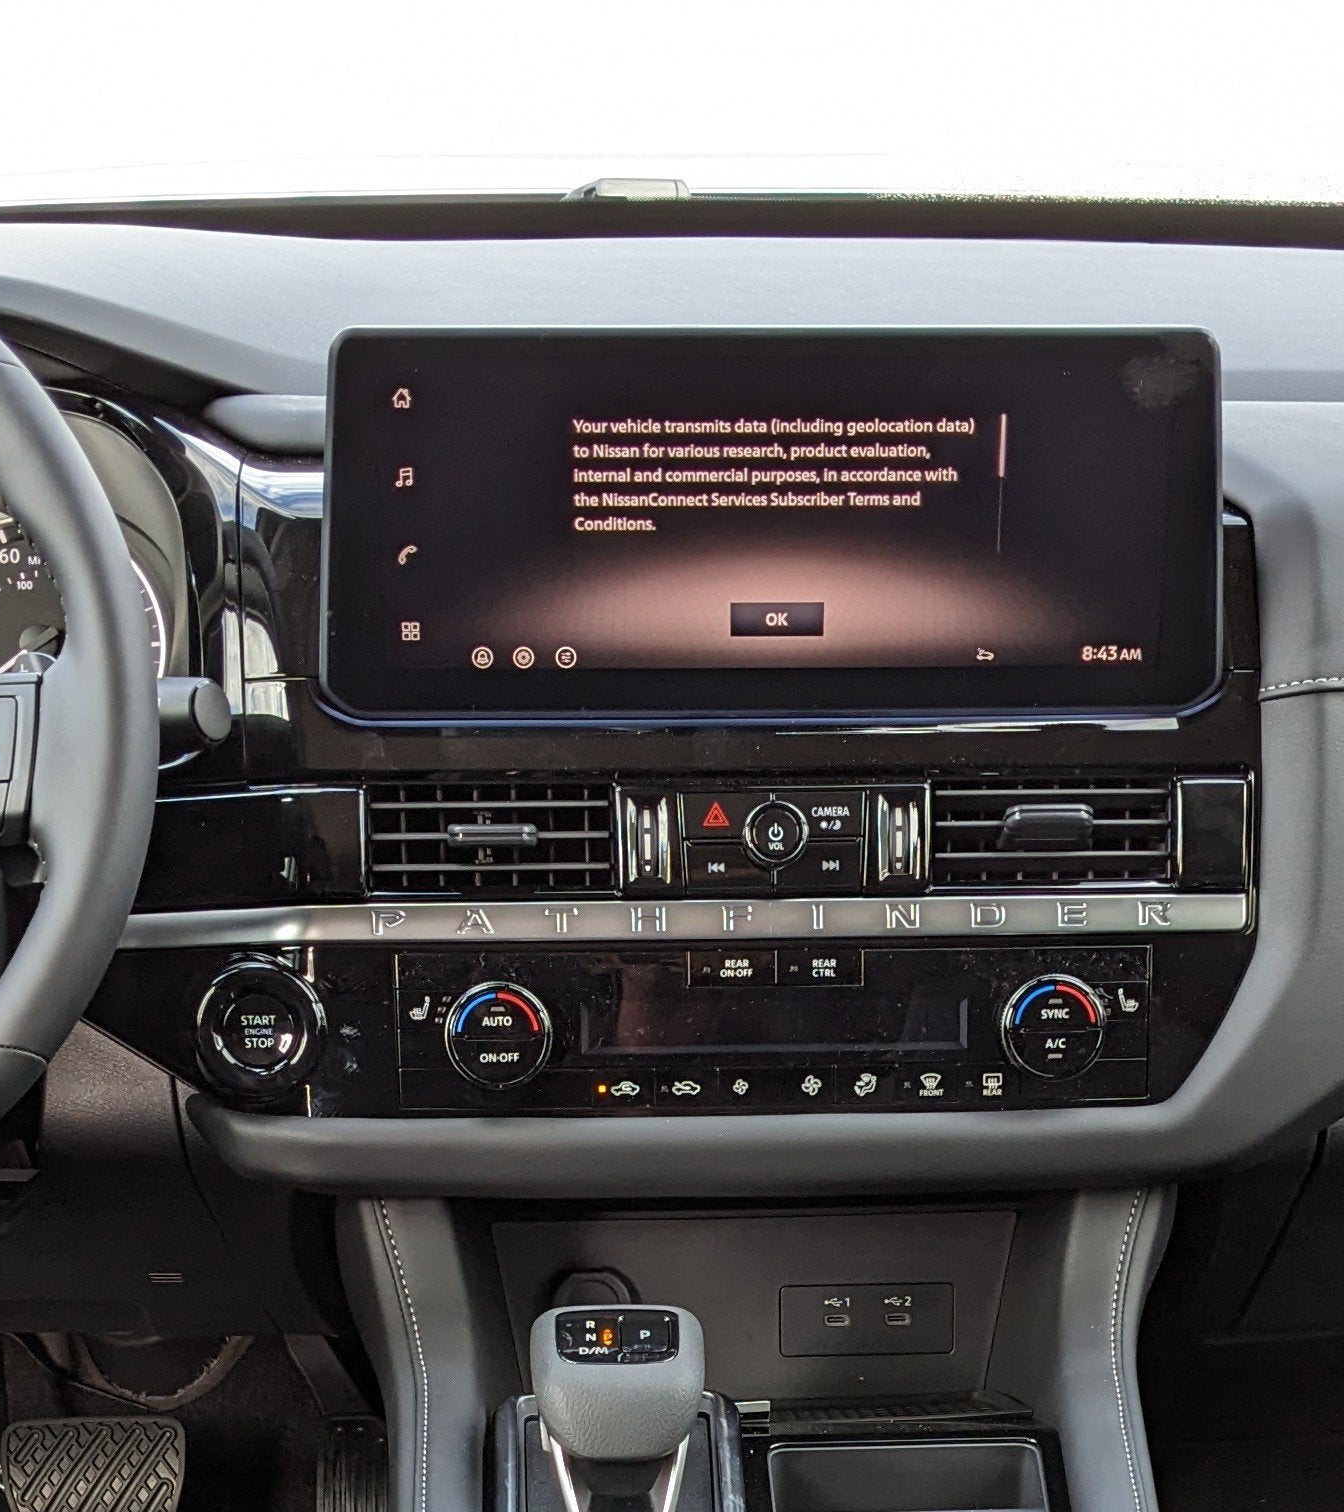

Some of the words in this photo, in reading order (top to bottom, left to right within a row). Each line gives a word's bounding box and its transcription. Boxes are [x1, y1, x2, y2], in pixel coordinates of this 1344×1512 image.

[573, 420, 608, 433] Your
[610, 419, 661, 433] vehicle
[664, 420, 731, 433] transmits
[734, 419, 767, 433] data
[771, 418, 843, 435] (including
[847, 418, 932, 436] geolocation
[937, 418, 974, 434] data)
[573, 446, 589, 457] to
[593, 445, 639, 457] Nissan
[643, 443, 665, 457] for
[668, 444, 719, 457] various
[723, 443, 787, 459] research,
[791, 443, 847, 460] product
[850, 443, 930, 459] evaluation,
[574, 468, 630, 482] internal
[634, 468, 662, 482] and
[665, 468, 747, 482] commercial
[751, 469, 820, 485] purposes,
[823, 468, 837, 481] in
[841, 468, 921, 482] accordance
[925, 467, 958, 482] with
[574, 493, 598, 506] the
[602, 493, 708, 506] NissanConnect
[711, 493, 767, 506] Services
[770, 492, 845, 506] Subscriber
[847, 492, 889, 506] Terms
[893, 492, 921, 506] and
[574, 517, 656, 531] Conditions.
[0, 549, 20, 564] 60
[17, 580, 33, 590] 100
[766, 613, 788, 626] OK
[1082, 646, 1117, 661] 8:43
[1119, 649, 1142, 661] AM
[812, 807, 850, 817] CAMERA
[369, 901, 1173, 937] PATHFINDER
[724, 959, 749, 968] REAR
[812, 959, 836, 968] REAR
[812, 968, 836, 978] CTRL
[1041, 1009, 1069, 1019] SYNC
[240, 1015, 275, 1026] START
[482, 1016, 512, 1027] AUTO
[244, 1037, 275, 1049] STOP
[1045, 1038, 1066, 1049] A/C
[983, 1088, 1002, 1096] REAR
[846, 1298, 850, 1306] 1
[905, 1297, 911, 1306] 2
[640, 1330, 651, 1339] P
[579, 1347, 609, 1355] D/M
